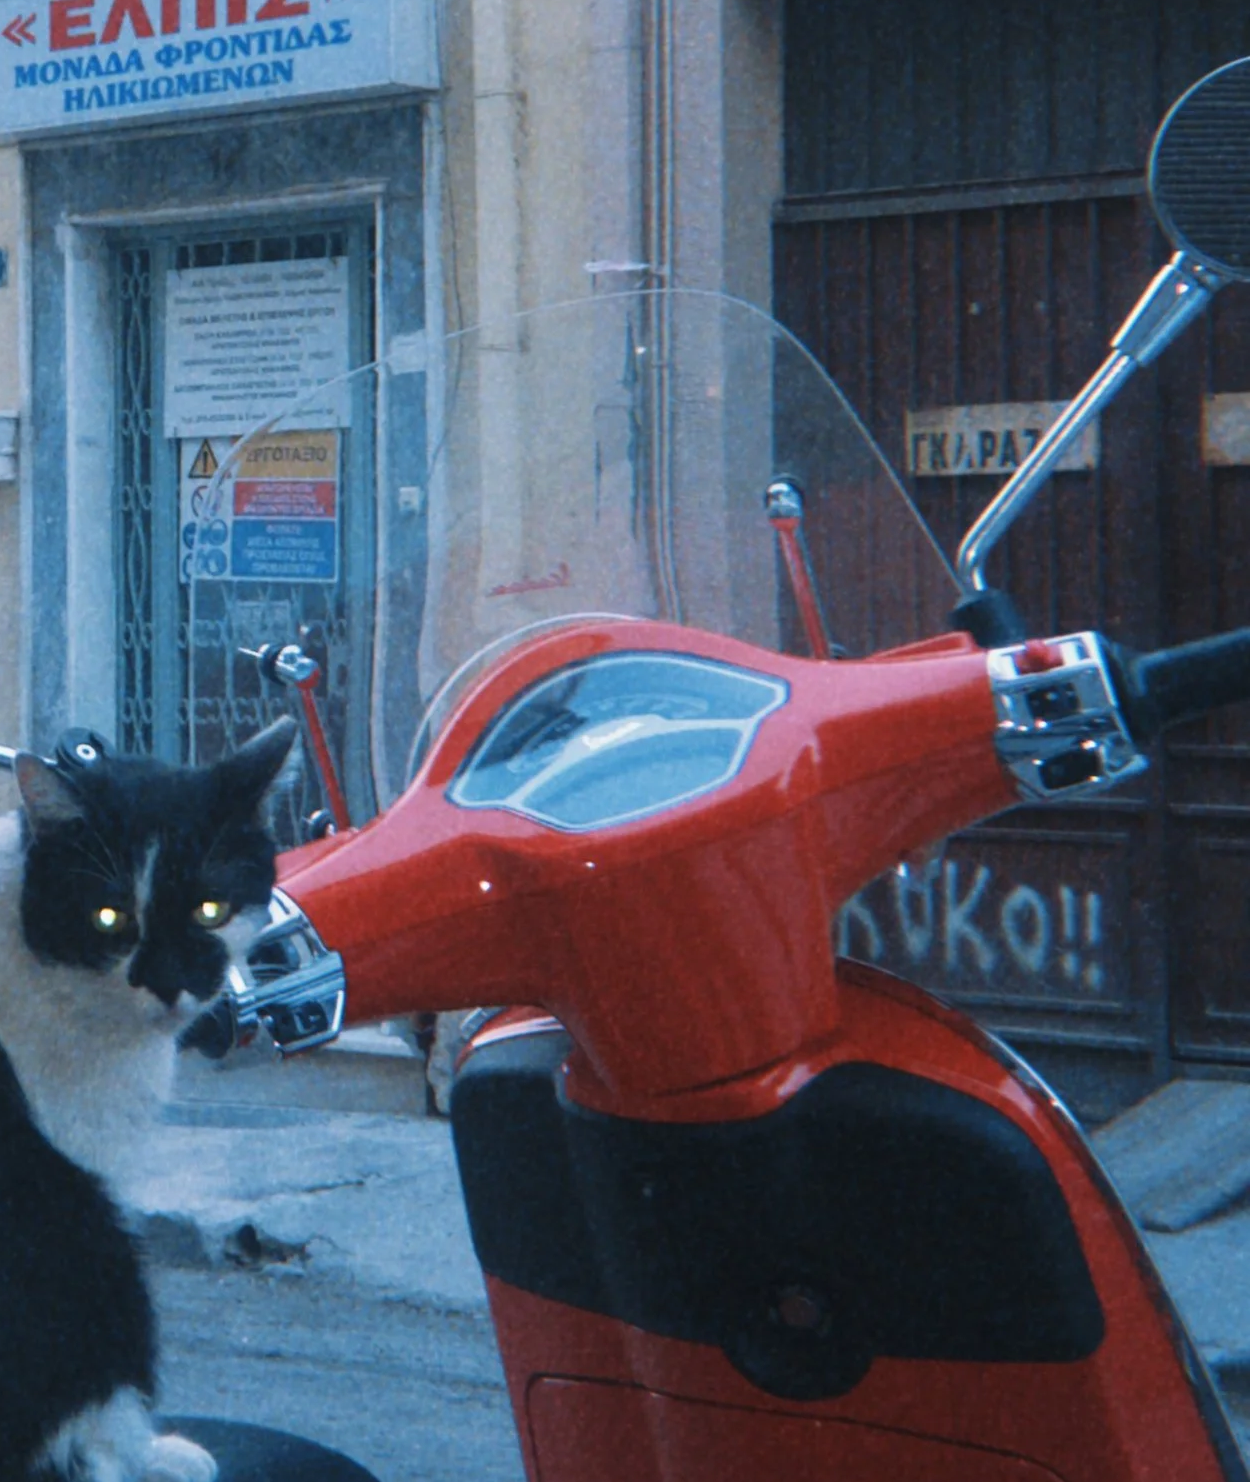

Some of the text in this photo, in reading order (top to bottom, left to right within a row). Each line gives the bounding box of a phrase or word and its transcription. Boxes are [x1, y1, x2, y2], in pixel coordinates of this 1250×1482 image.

[14, 19, 352, 89] ΜΟΝΑΔΑ ΦΡΟΝΤΙΔΑΣ
[63, 58, 296, 113] ΗΛΙΚΙΩΜΕΝΩΝ
